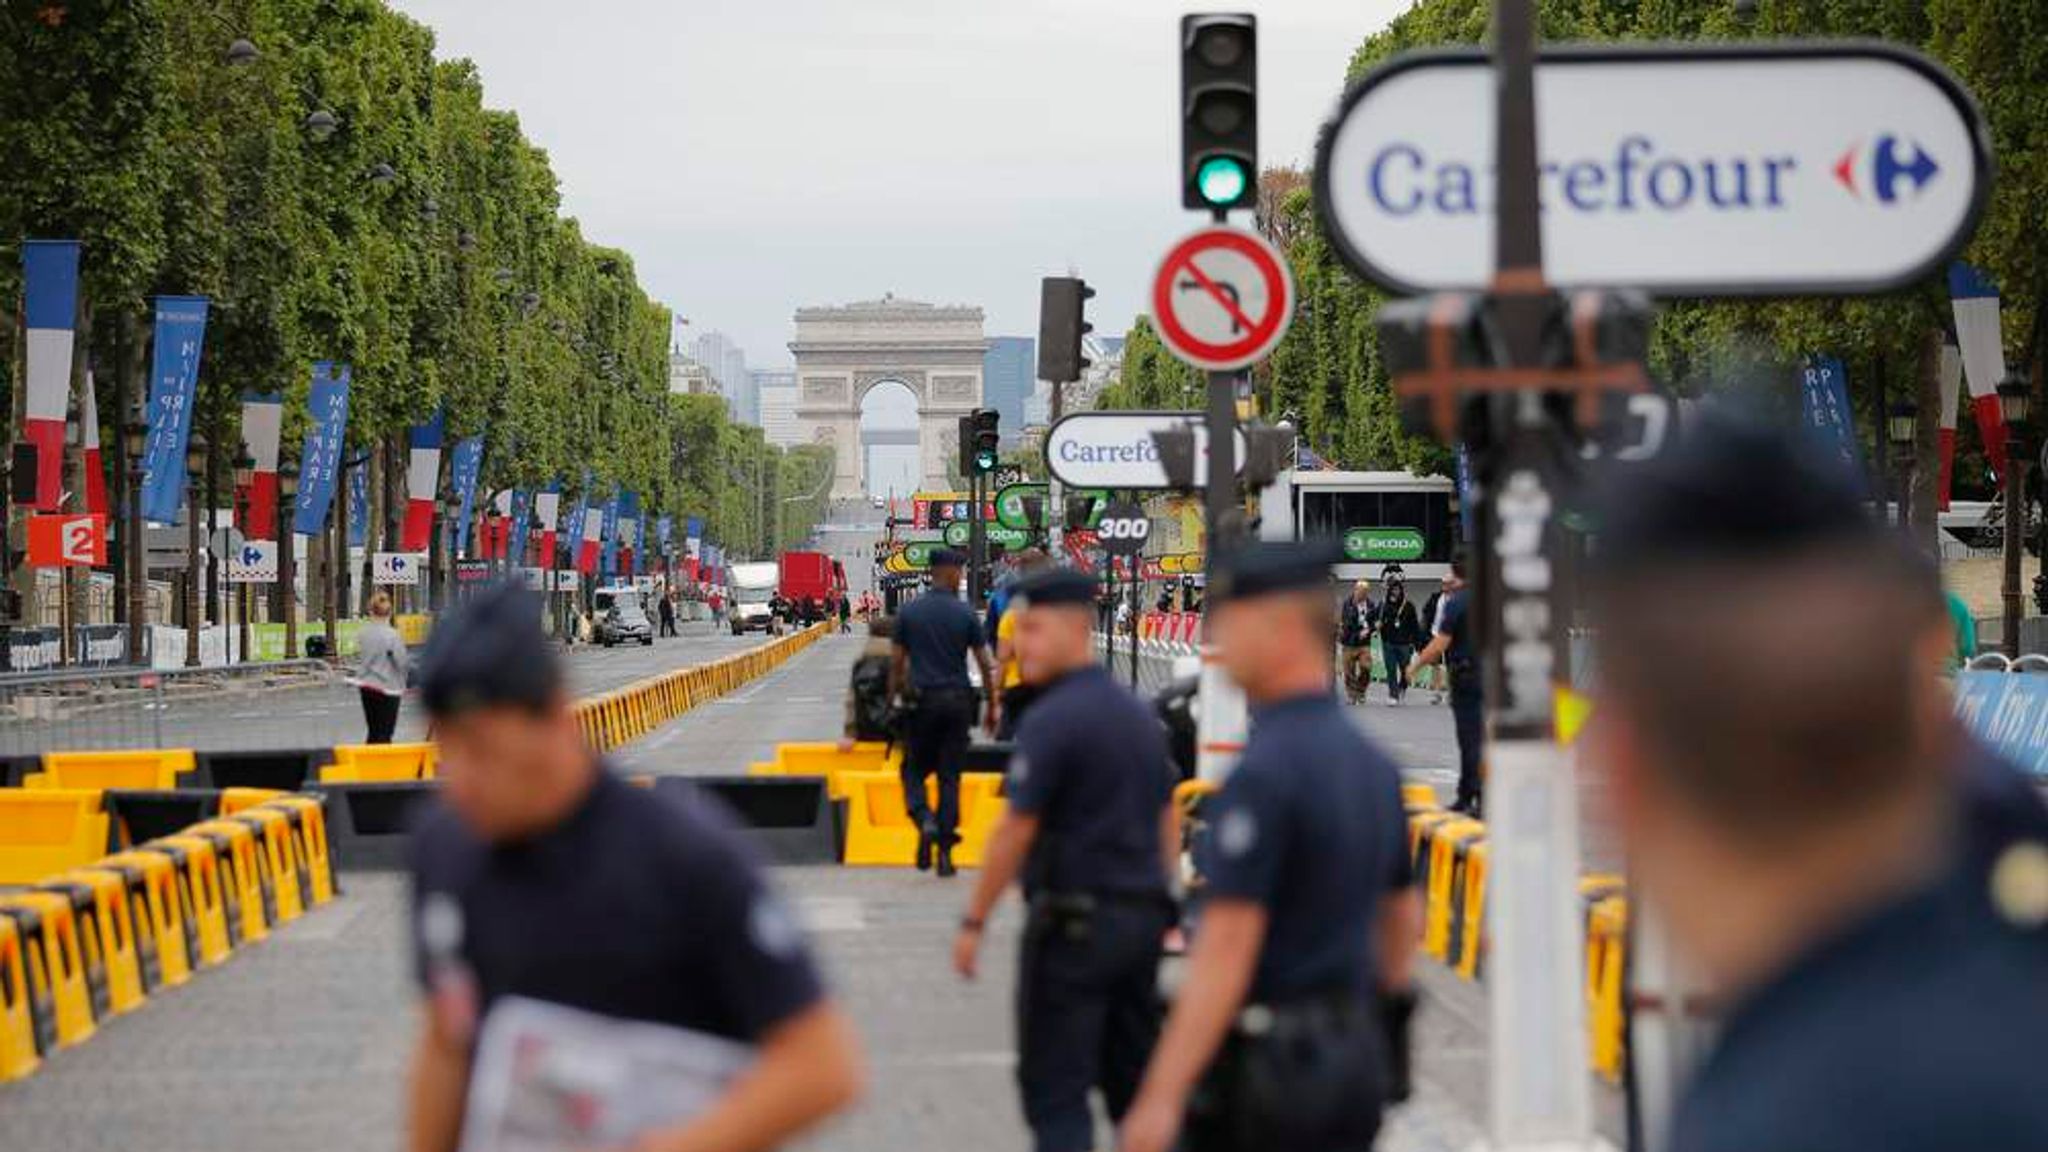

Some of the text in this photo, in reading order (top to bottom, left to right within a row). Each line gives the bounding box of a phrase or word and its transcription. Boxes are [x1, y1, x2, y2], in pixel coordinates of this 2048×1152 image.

[1366, 134, 1797, 217] Carefour
[1060, 439, 1161, 463] Carrefo
[71, 526, 95, 555] 2
[1097, 517, 1149, 539] 300
